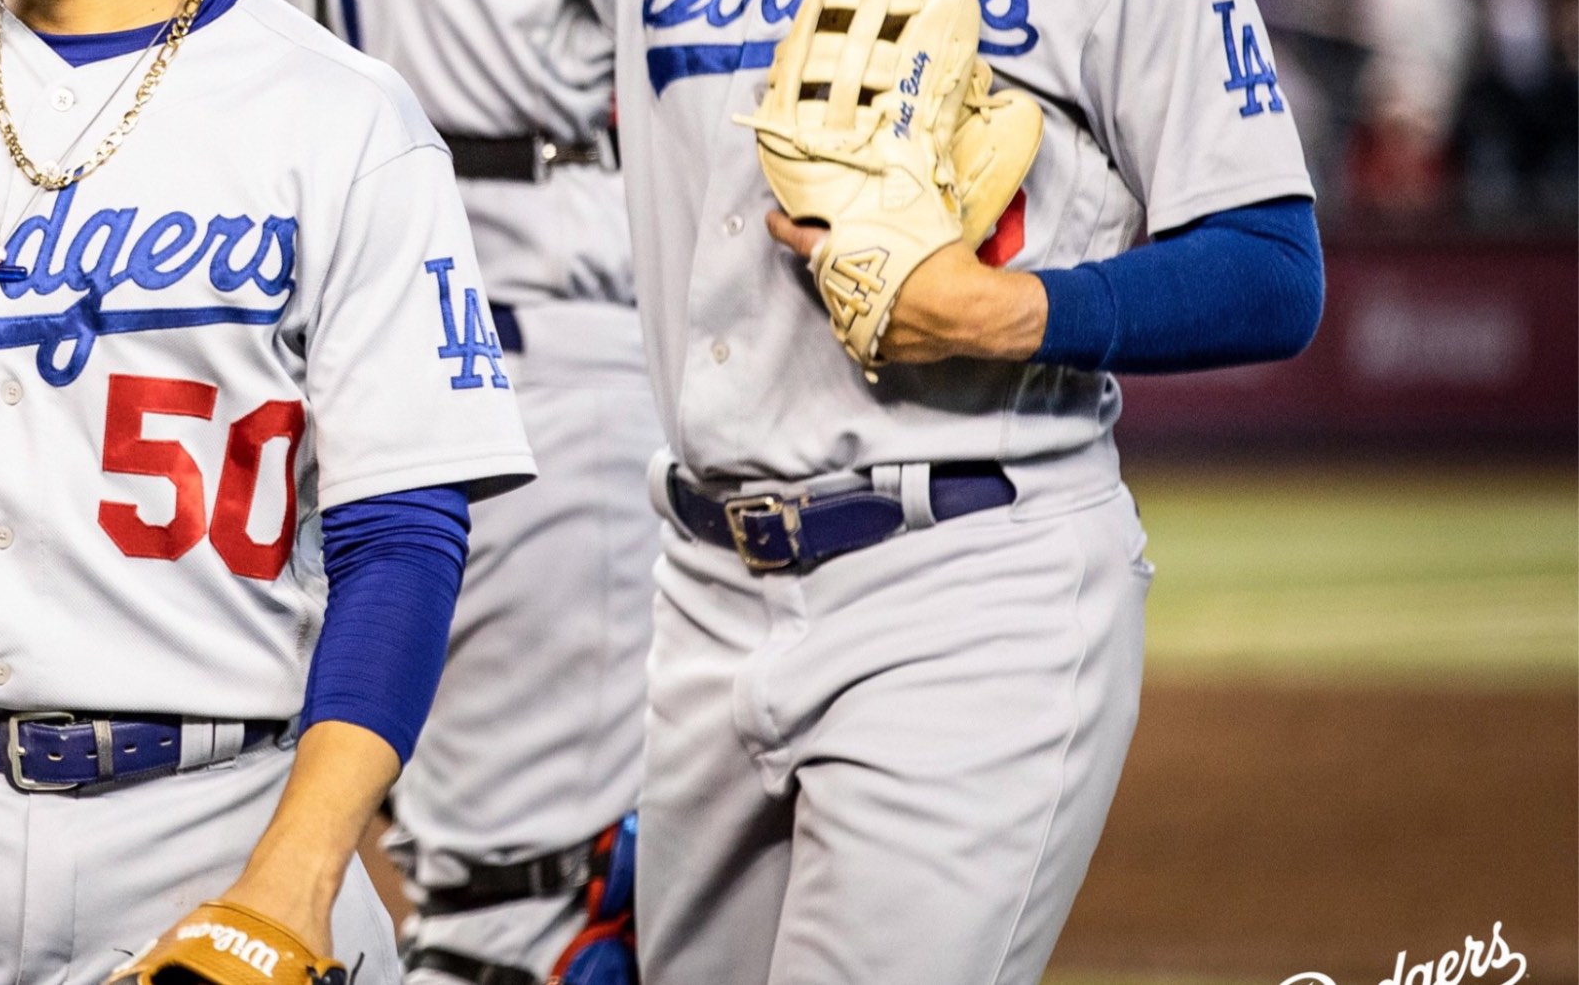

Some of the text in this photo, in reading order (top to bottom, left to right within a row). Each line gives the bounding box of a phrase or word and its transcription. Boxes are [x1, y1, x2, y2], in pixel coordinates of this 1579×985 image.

[1212, 0, 1285, 117] LA
[424, 256, 510, 391] LA
[824, 246, 891, 332] 44
[97, 373, 308, 582] 50
[177, 922, 280, 978] Wilson
